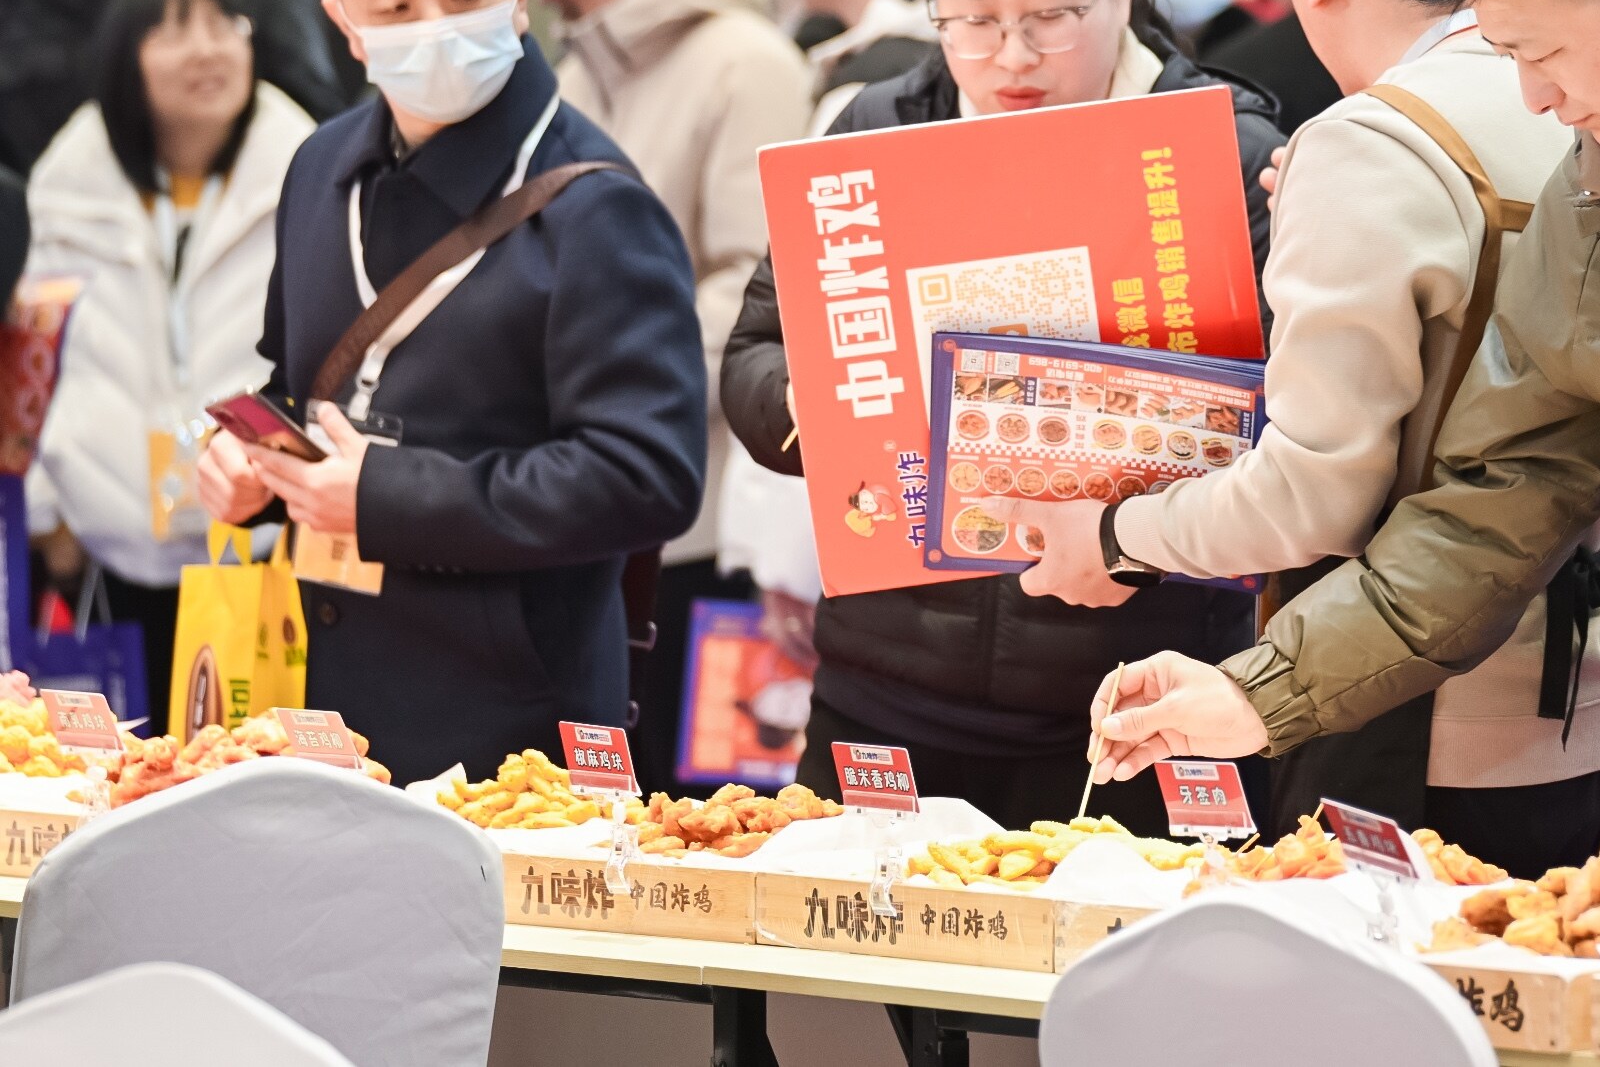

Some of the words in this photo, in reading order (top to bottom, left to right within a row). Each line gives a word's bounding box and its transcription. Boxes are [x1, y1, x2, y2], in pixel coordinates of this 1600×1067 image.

[807, 168, 905, 419] 中国炸鸡
[896, 450, 928, 549] 九味炸
[293, 729, 344, 750] 海苔鸡柳
[573, 746, 625, 771] 椒麻鸡块
[843, 766, 910, 792] 脆米香鸡柳
[1178, 785, 1228, 806] 牙签肉
[521, 865, 615, 920] 九味炸
[630, 879, 713, 914] 中国炸鸡
[804, 887, 904, 945] 九味炸
[919, 903, 1008, 941] 中国炸鸡
